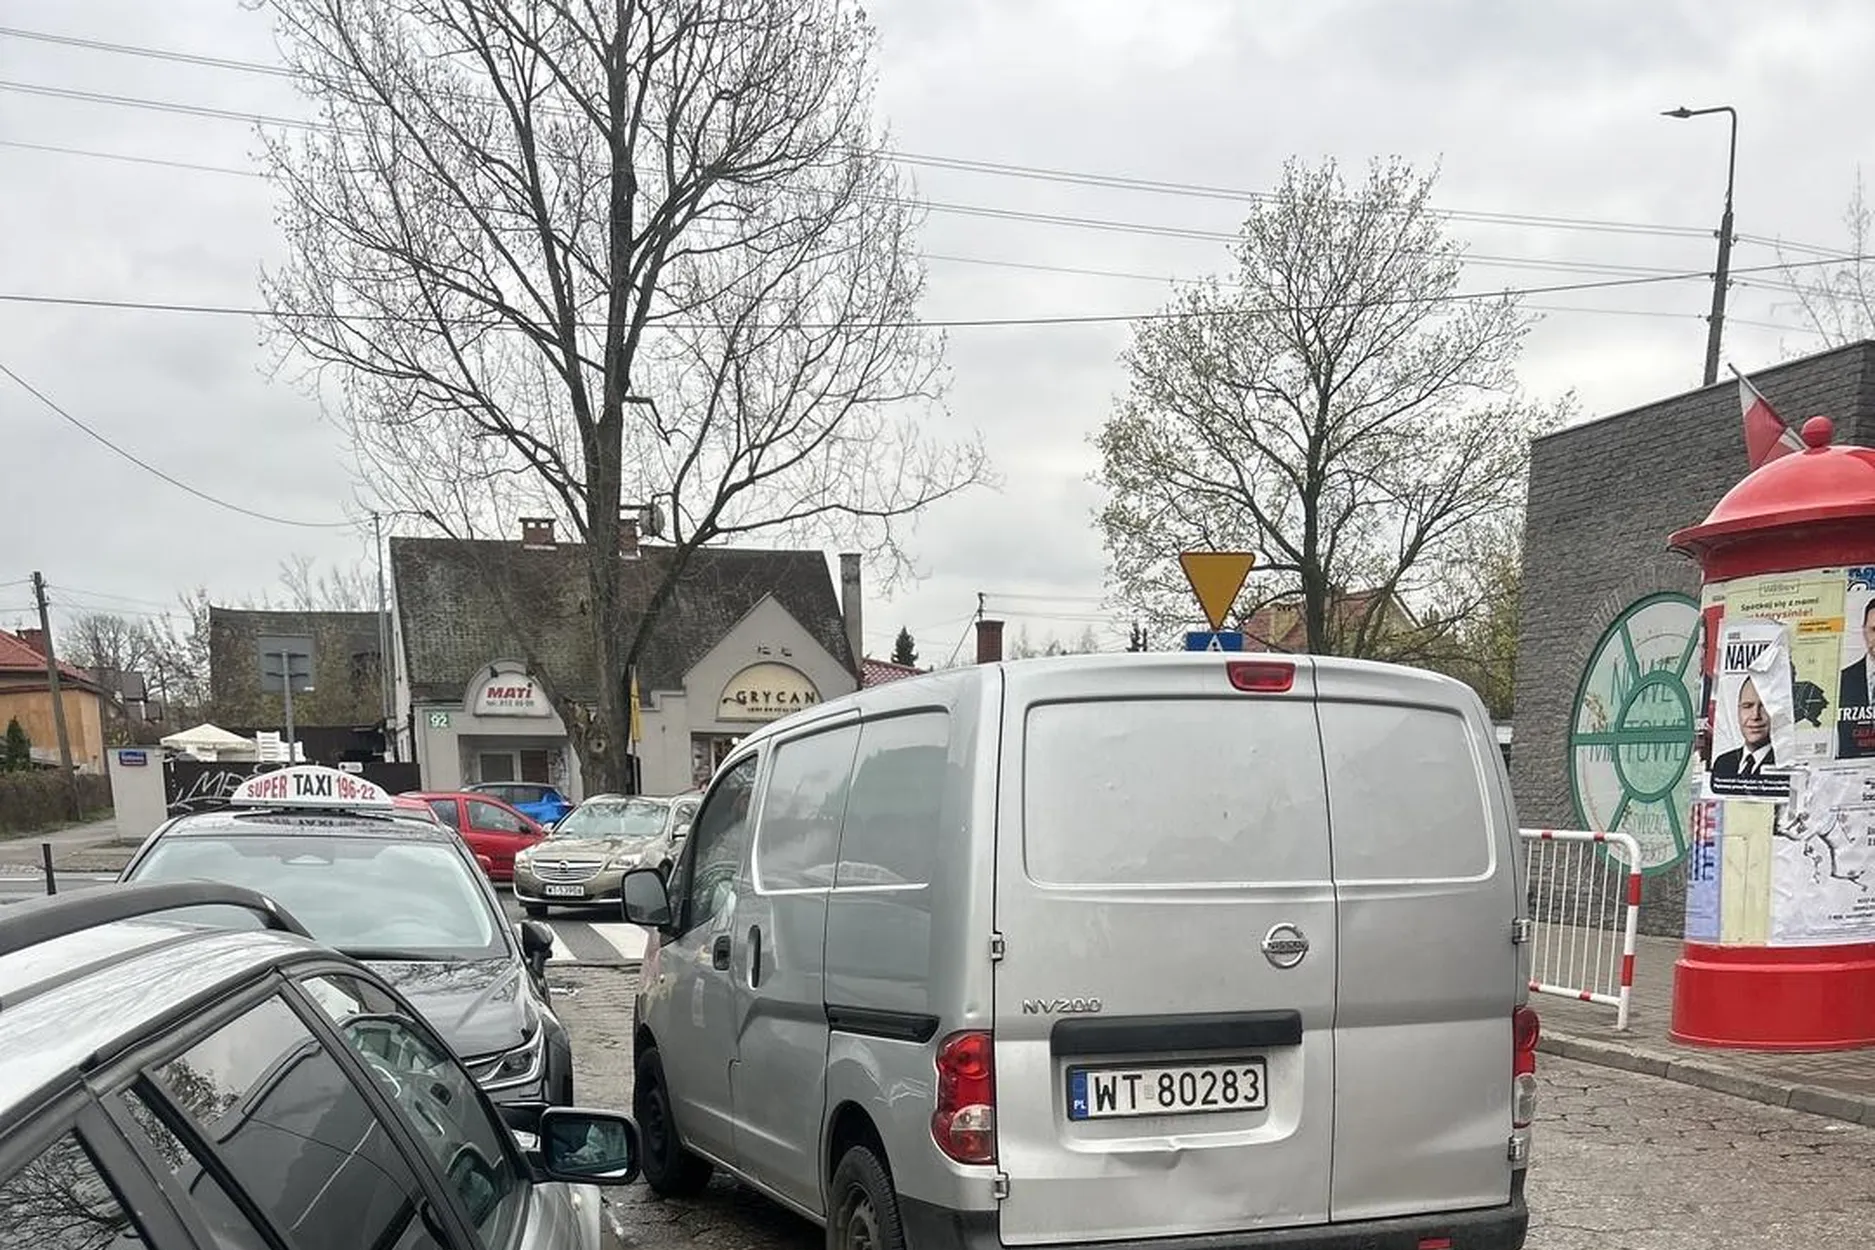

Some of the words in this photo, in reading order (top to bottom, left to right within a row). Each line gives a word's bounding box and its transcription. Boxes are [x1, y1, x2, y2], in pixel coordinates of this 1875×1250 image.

[1725, 643, 1770, 671] NAW
[723, 690, 815, 705] GRYCAN
[430, 713, 447, 728] 92
[1838, 706, 1875, 722] TRZAS
[248, 775, 288, 798] SUPER
[293, 774, 332, 797] TAXI
[337, 775, 376, 800] 196-22
[1022, 999, 1102, 1014] NV200
[1094, 1074, 1142, 1112] WT
[1157, 1068, 1260, 1108] 80283
[1074, 1100, 1087, 1110] PL
